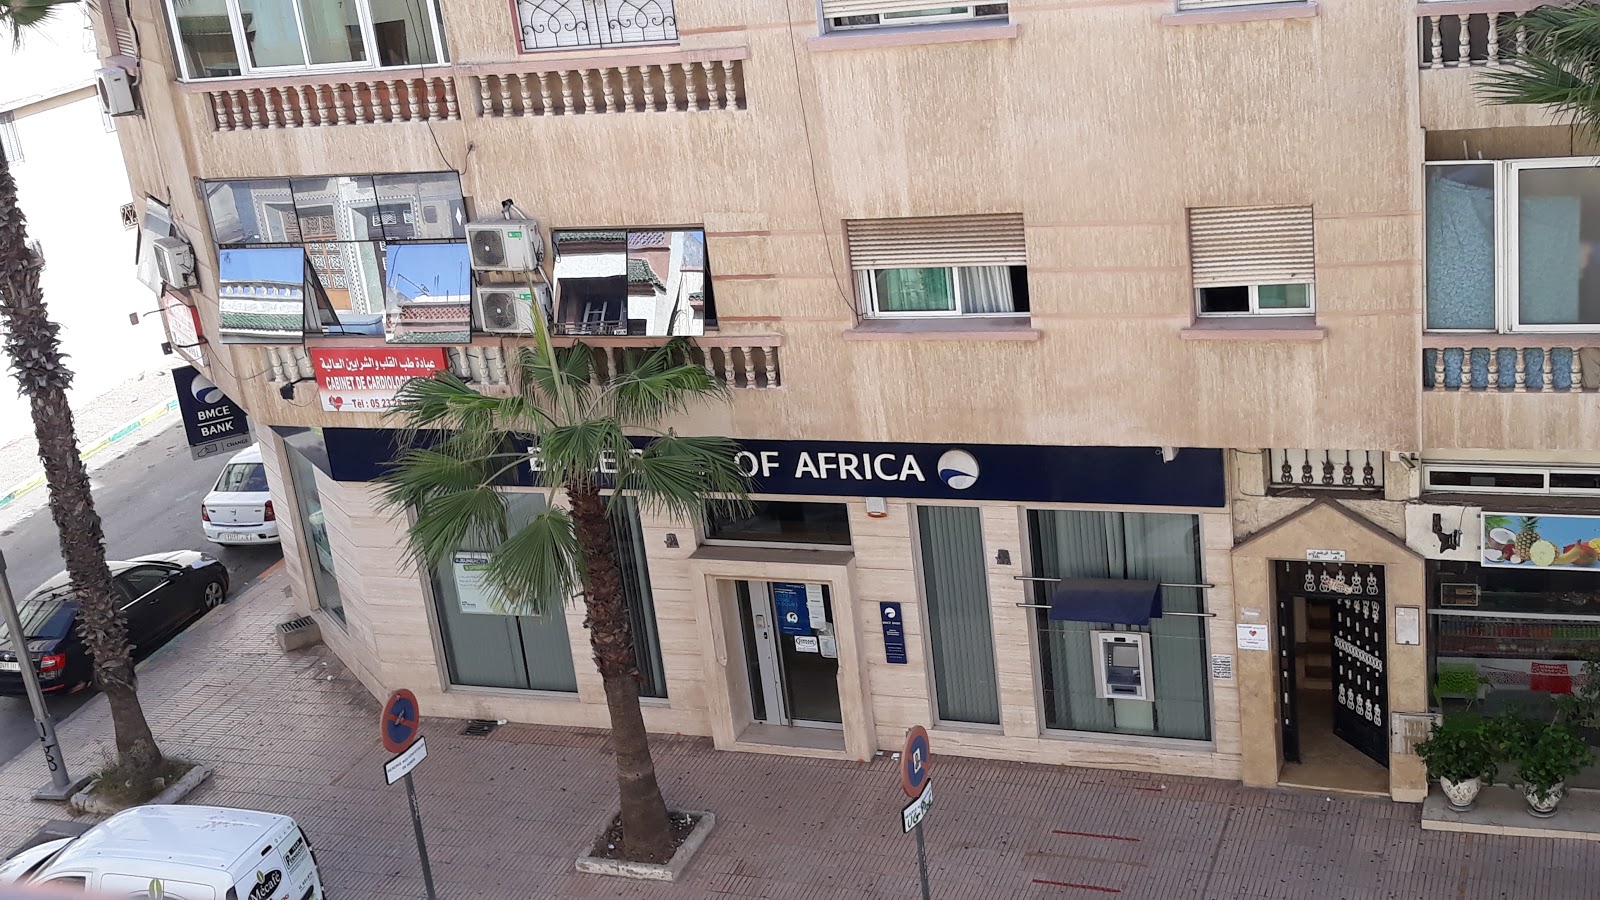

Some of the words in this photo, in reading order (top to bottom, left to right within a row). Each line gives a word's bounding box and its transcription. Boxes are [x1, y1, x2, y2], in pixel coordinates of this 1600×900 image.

[319, 357, 345, 372] العالية
[380, 356, 398, 371] القلب
[400, 357, 415, 371] طب
[416, 357, 435, 371] عيادة
[326, 376, 355, 391] CABINET
[355, 376, 366, 390] DE
[371, 399, 380, 408] 05
[197, 405, 231, 421] BMCE
[201, 421, 234, 437] BANK
[226, 438, 248, 448] CHANGE
[733, 450, 780, 478] OF
[795, 451, 926, 482] AFRICA
[250, 871, 281, 900] Mécafé
